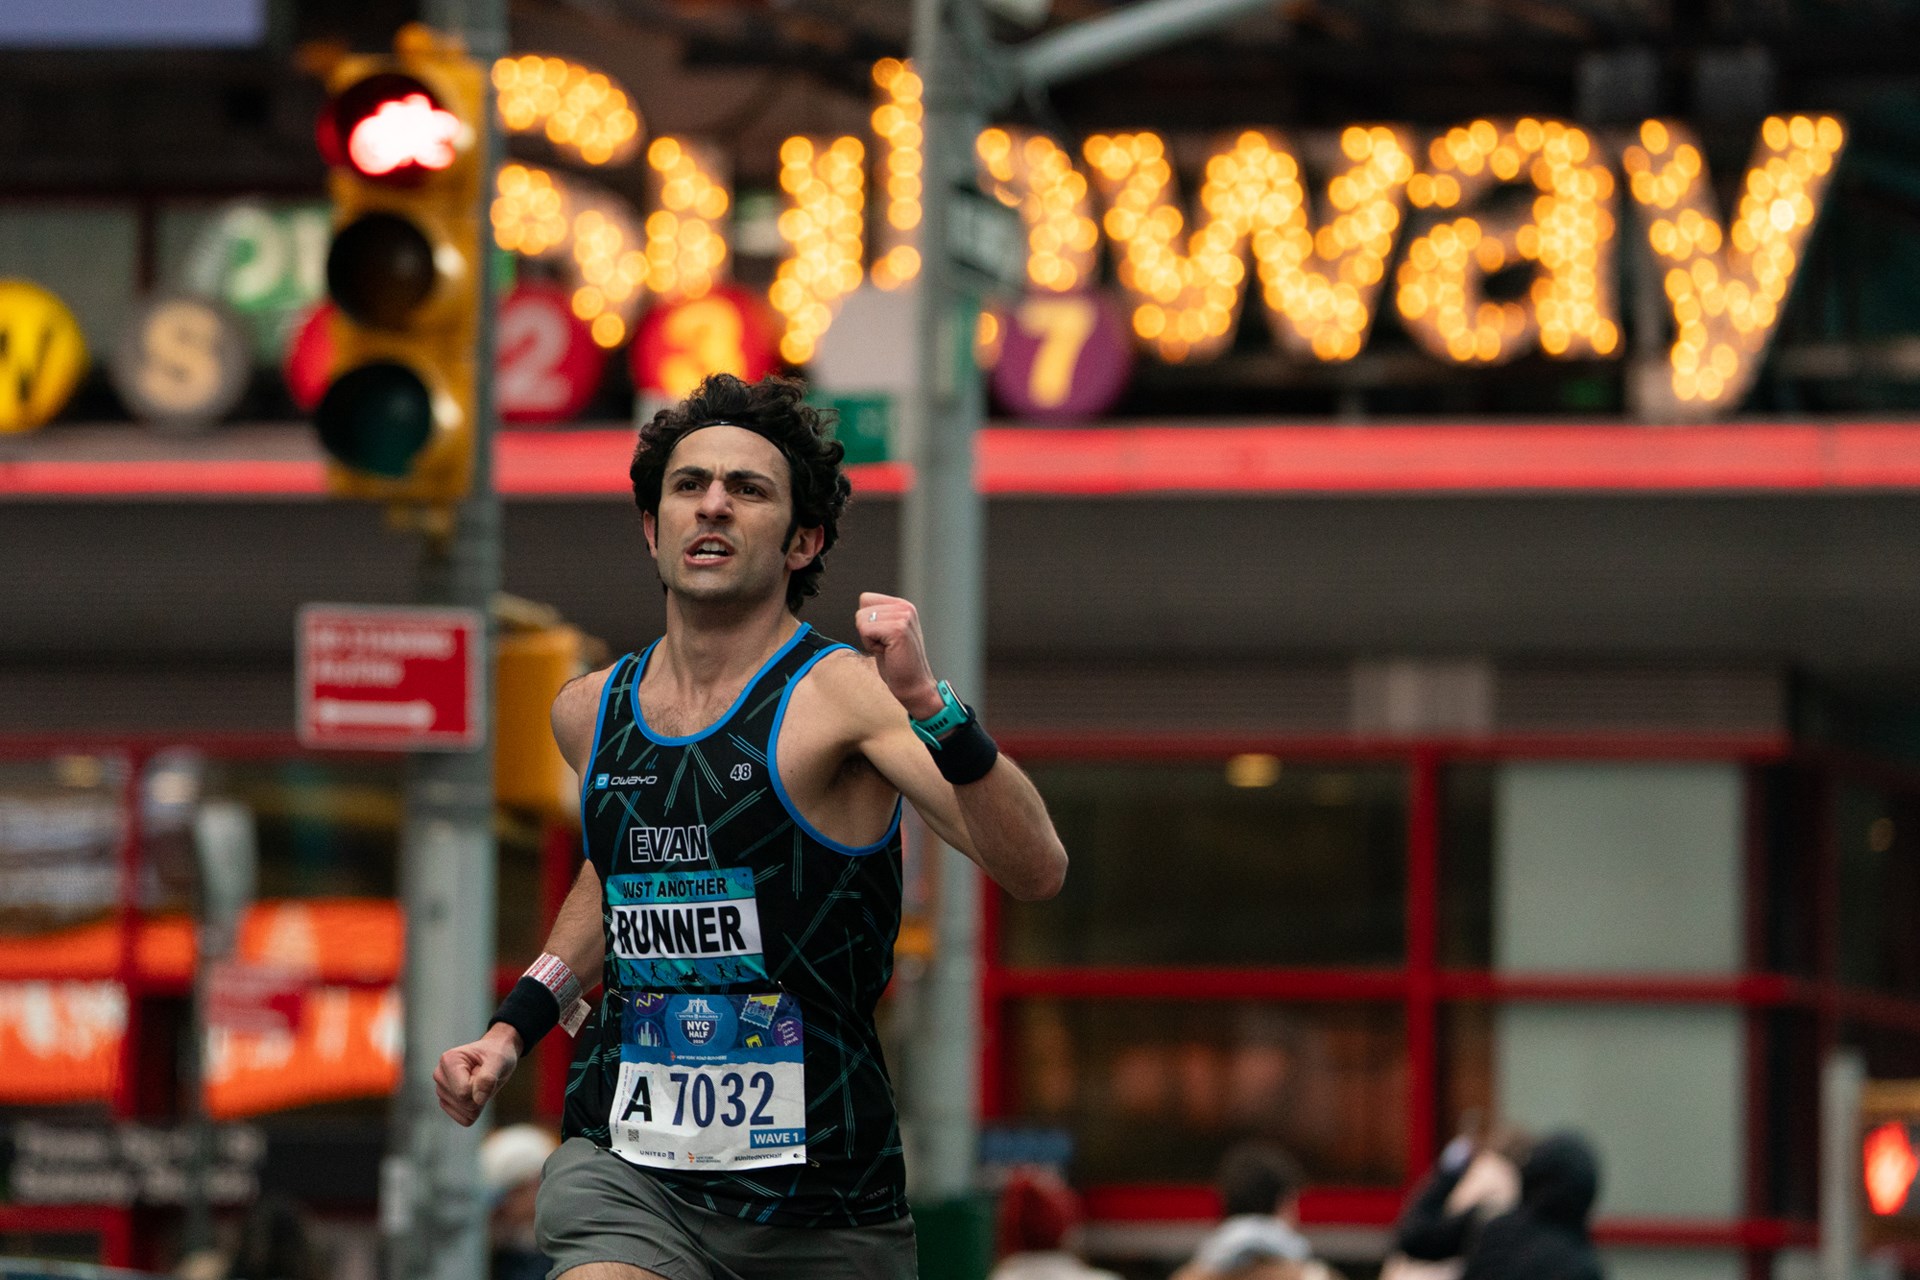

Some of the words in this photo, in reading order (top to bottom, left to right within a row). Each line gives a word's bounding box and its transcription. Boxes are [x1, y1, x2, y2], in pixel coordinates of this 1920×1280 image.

[140, 302, 224, 412] S
[496, 303, 573, 413] 2
[1020, 298, 1096, 407] 7
[730, 763, 752, 781] 48
[629, 825, 709, 863] EVAN
[622, 879, 652, 899] JUST
[656, 877, 728, 898] ANOTHER
[616, 905, 747, 955] RUNNER
[686, 1021, 710, 1031] NYC
[620, 1076, 653, 1122] A
[669, 1071, 775, 1128] 7032
[639, 1150, 667, 1158] UNITED
[754, 1132, 790, 1145] WAVE
[792, 1132, 799, 1143] 1
